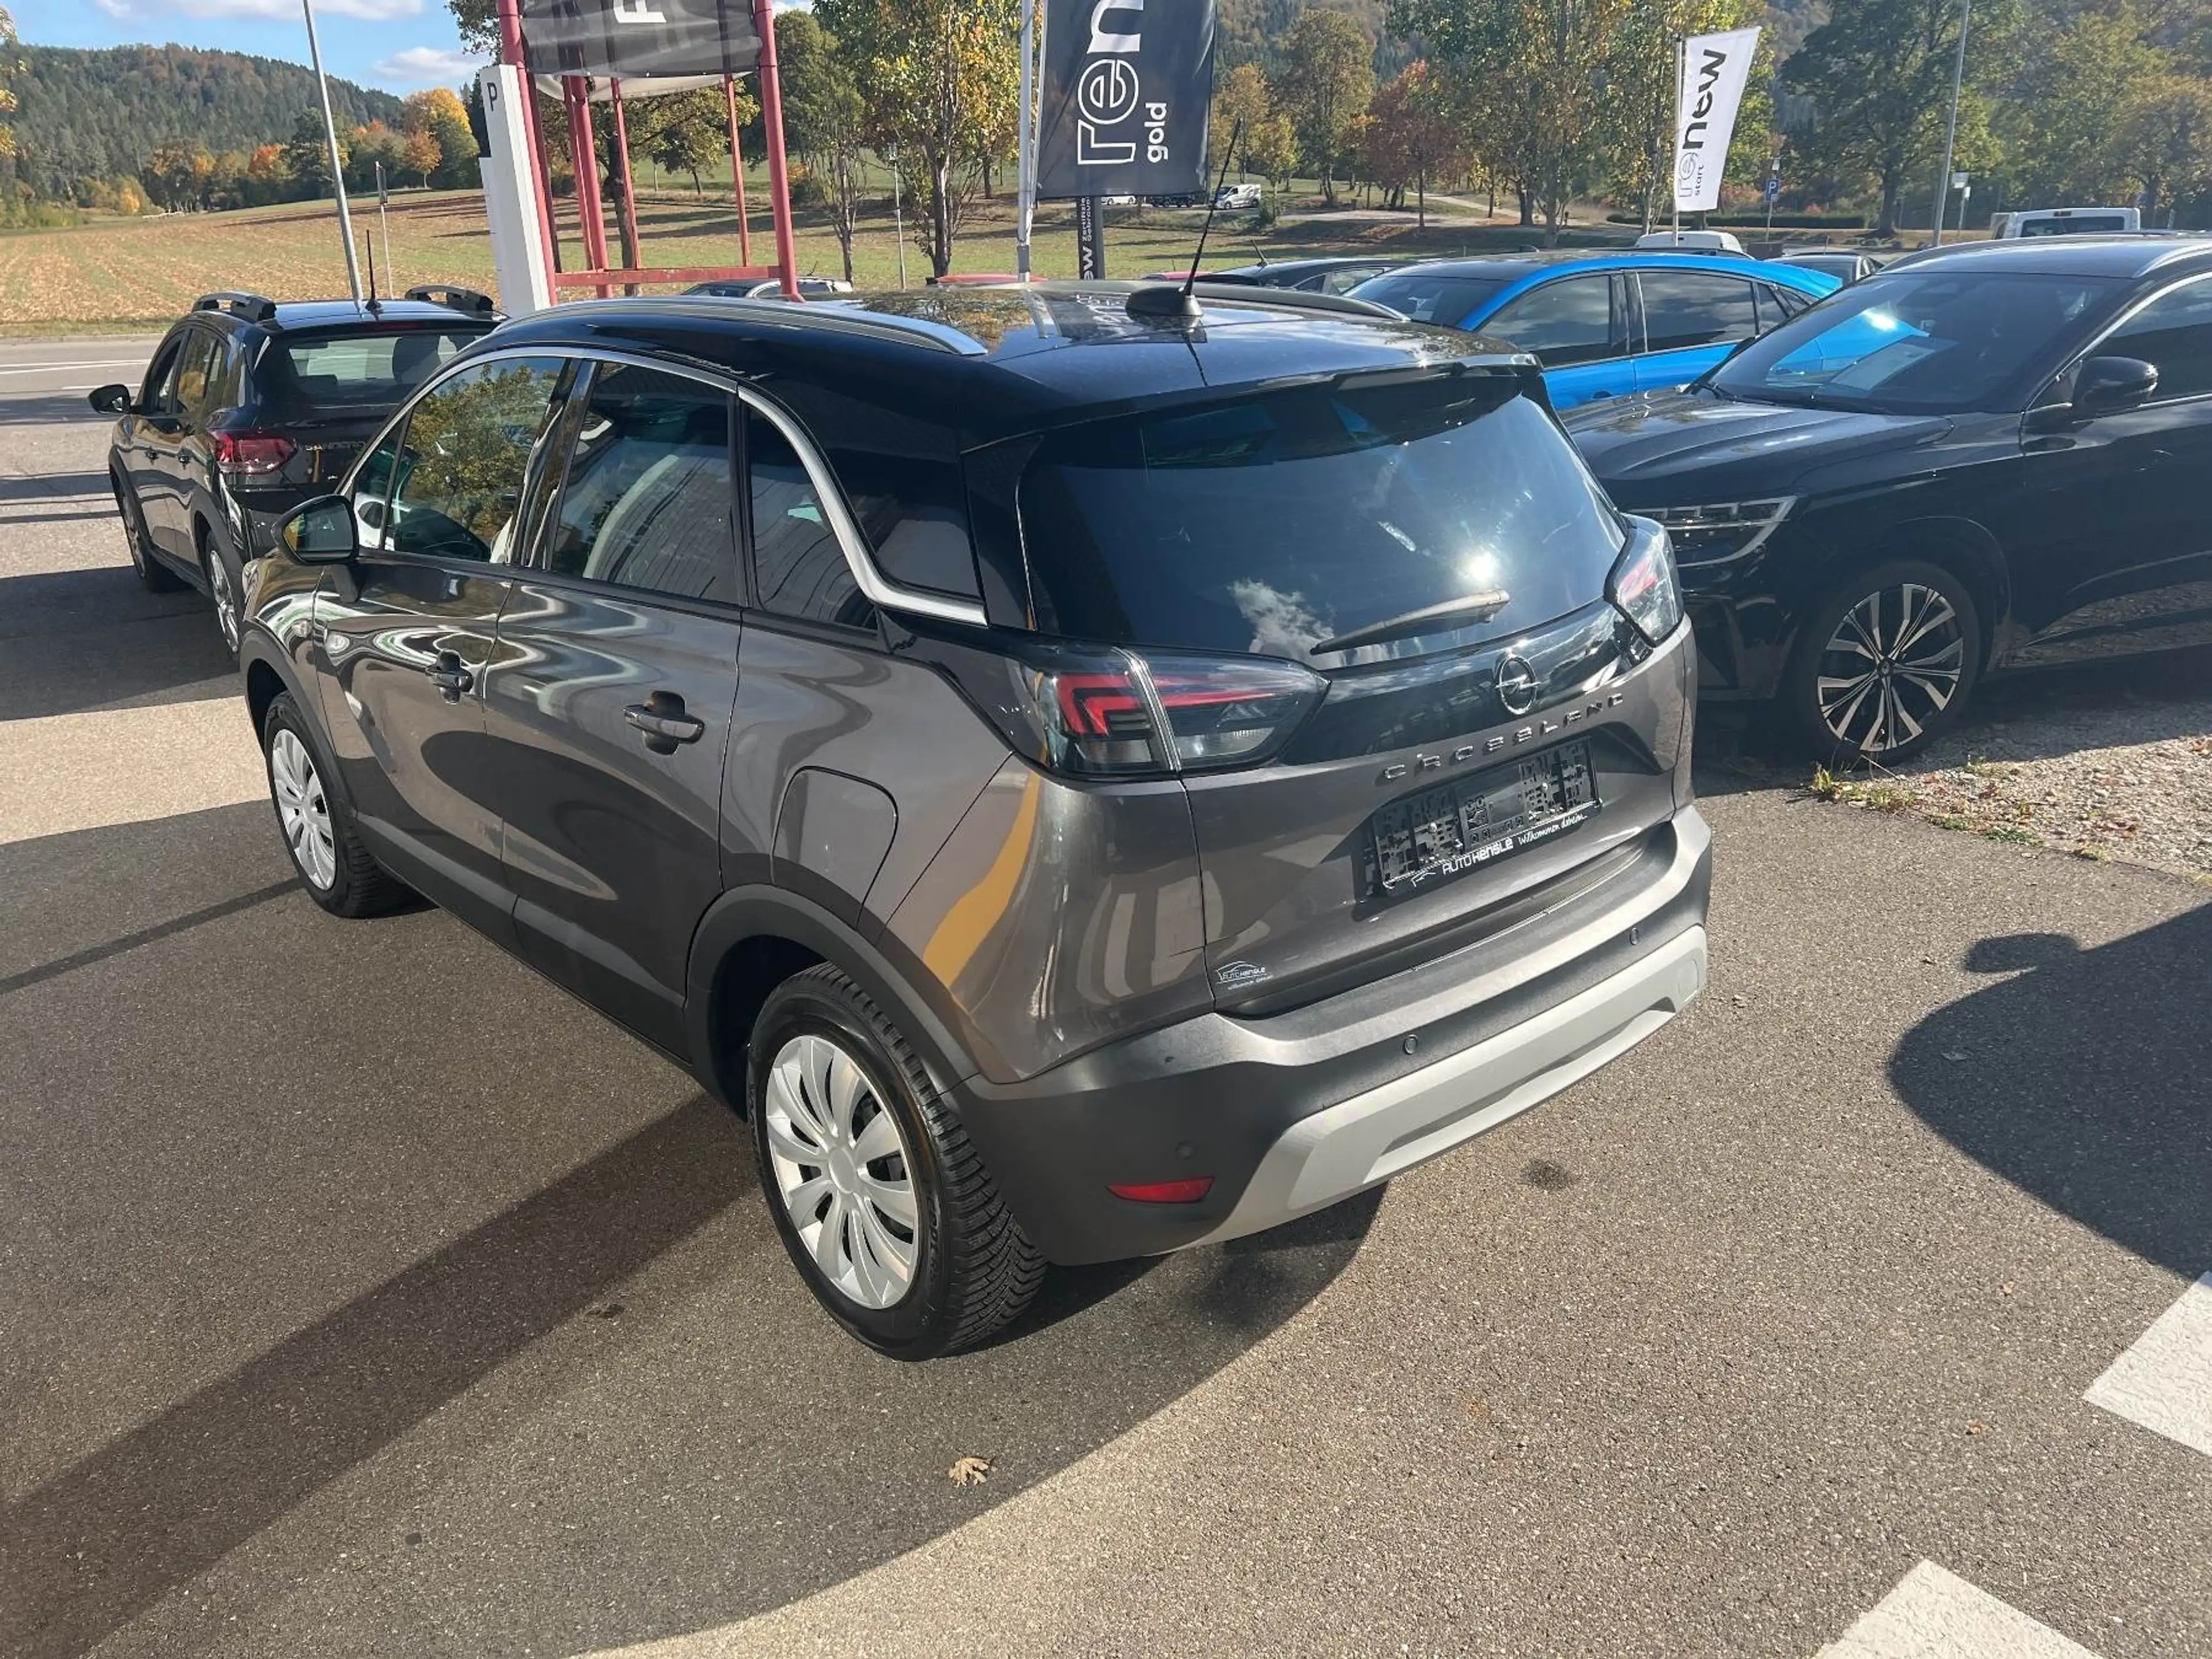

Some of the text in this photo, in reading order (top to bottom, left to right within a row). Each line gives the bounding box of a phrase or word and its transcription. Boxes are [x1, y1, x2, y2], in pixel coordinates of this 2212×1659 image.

[486, 82, 498, 112] P
[1144, 102, 1168, 163] gold
[1677, 48, 1727, 198] renew
[1694, 164, 1705, 196] start
[1768, 181, 1777, 194] P
